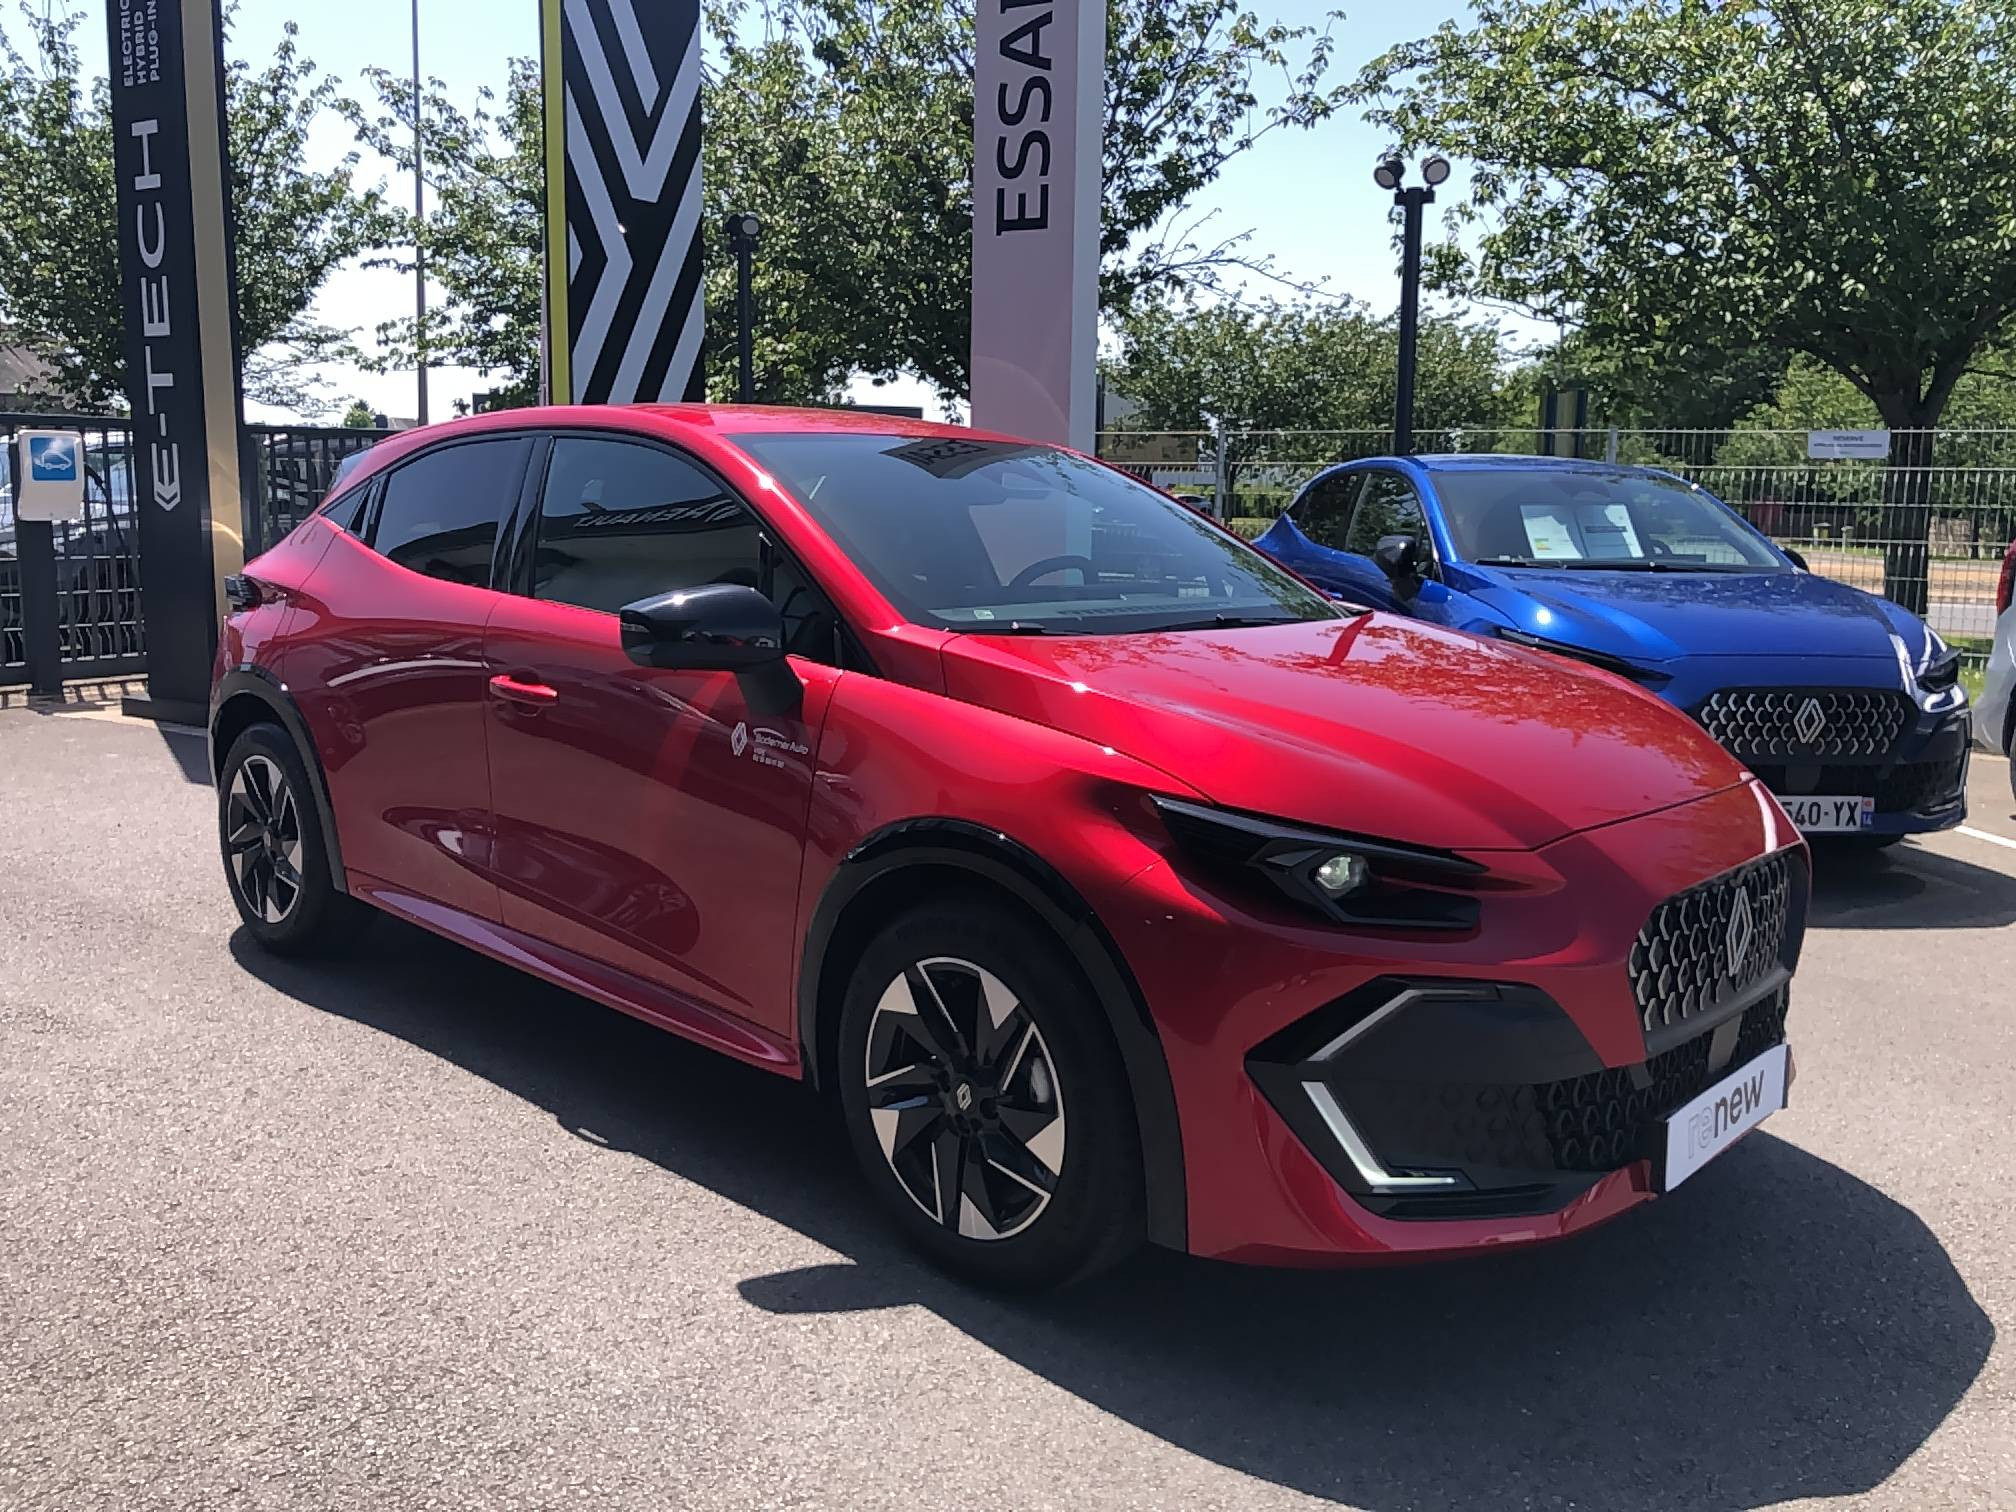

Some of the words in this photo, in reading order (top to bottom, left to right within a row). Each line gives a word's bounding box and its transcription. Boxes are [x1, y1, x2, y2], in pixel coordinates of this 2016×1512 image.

[133, 11, 147, 84] HYBRID
[146, 0, 160, 82] PLUG-IN
[131, 118, 181, 512] E-TECH
[790, 741, 809, 755] Auto
[1687, 1069, 1765, 1159] renew
